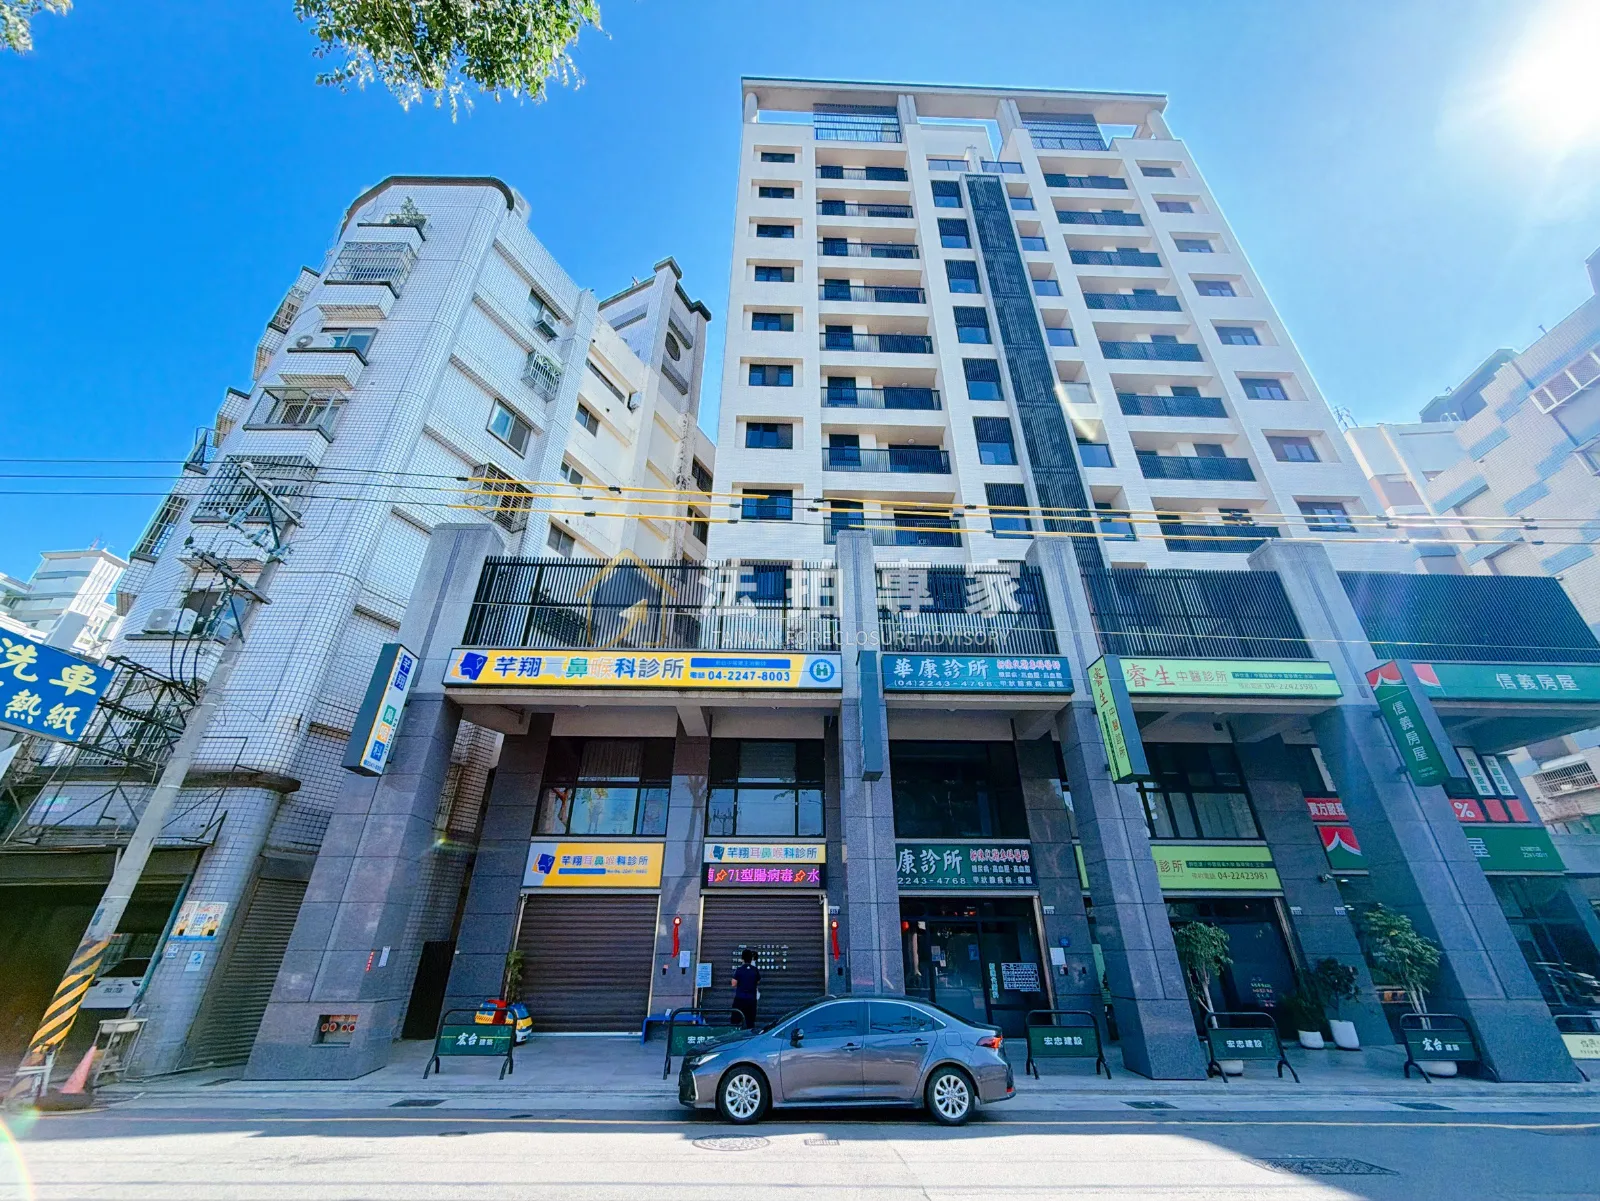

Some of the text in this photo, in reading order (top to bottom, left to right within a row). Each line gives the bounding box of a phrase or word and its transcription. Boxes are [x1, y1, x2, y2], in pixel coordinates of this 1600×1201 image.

[0, 638, 97, 696] 洗車
[893, 657, 989, 680] 華康診所
[708, 670, 790, 681] 04-2247-8003
[1496, 673, 1580, 690] 信義房屋
[0, 681, 81, 735] 熱紙
[897, 849, 962, 875] 康診所
[1155, 860, 1184, 873] 診所
[728, 868, 794, 882] 71型腸病毒
[807, 868, 820, 882] 水
[898, 877, 966, 885] 2243-4768
[1217, 872, 1269, 880] 04-22423981
